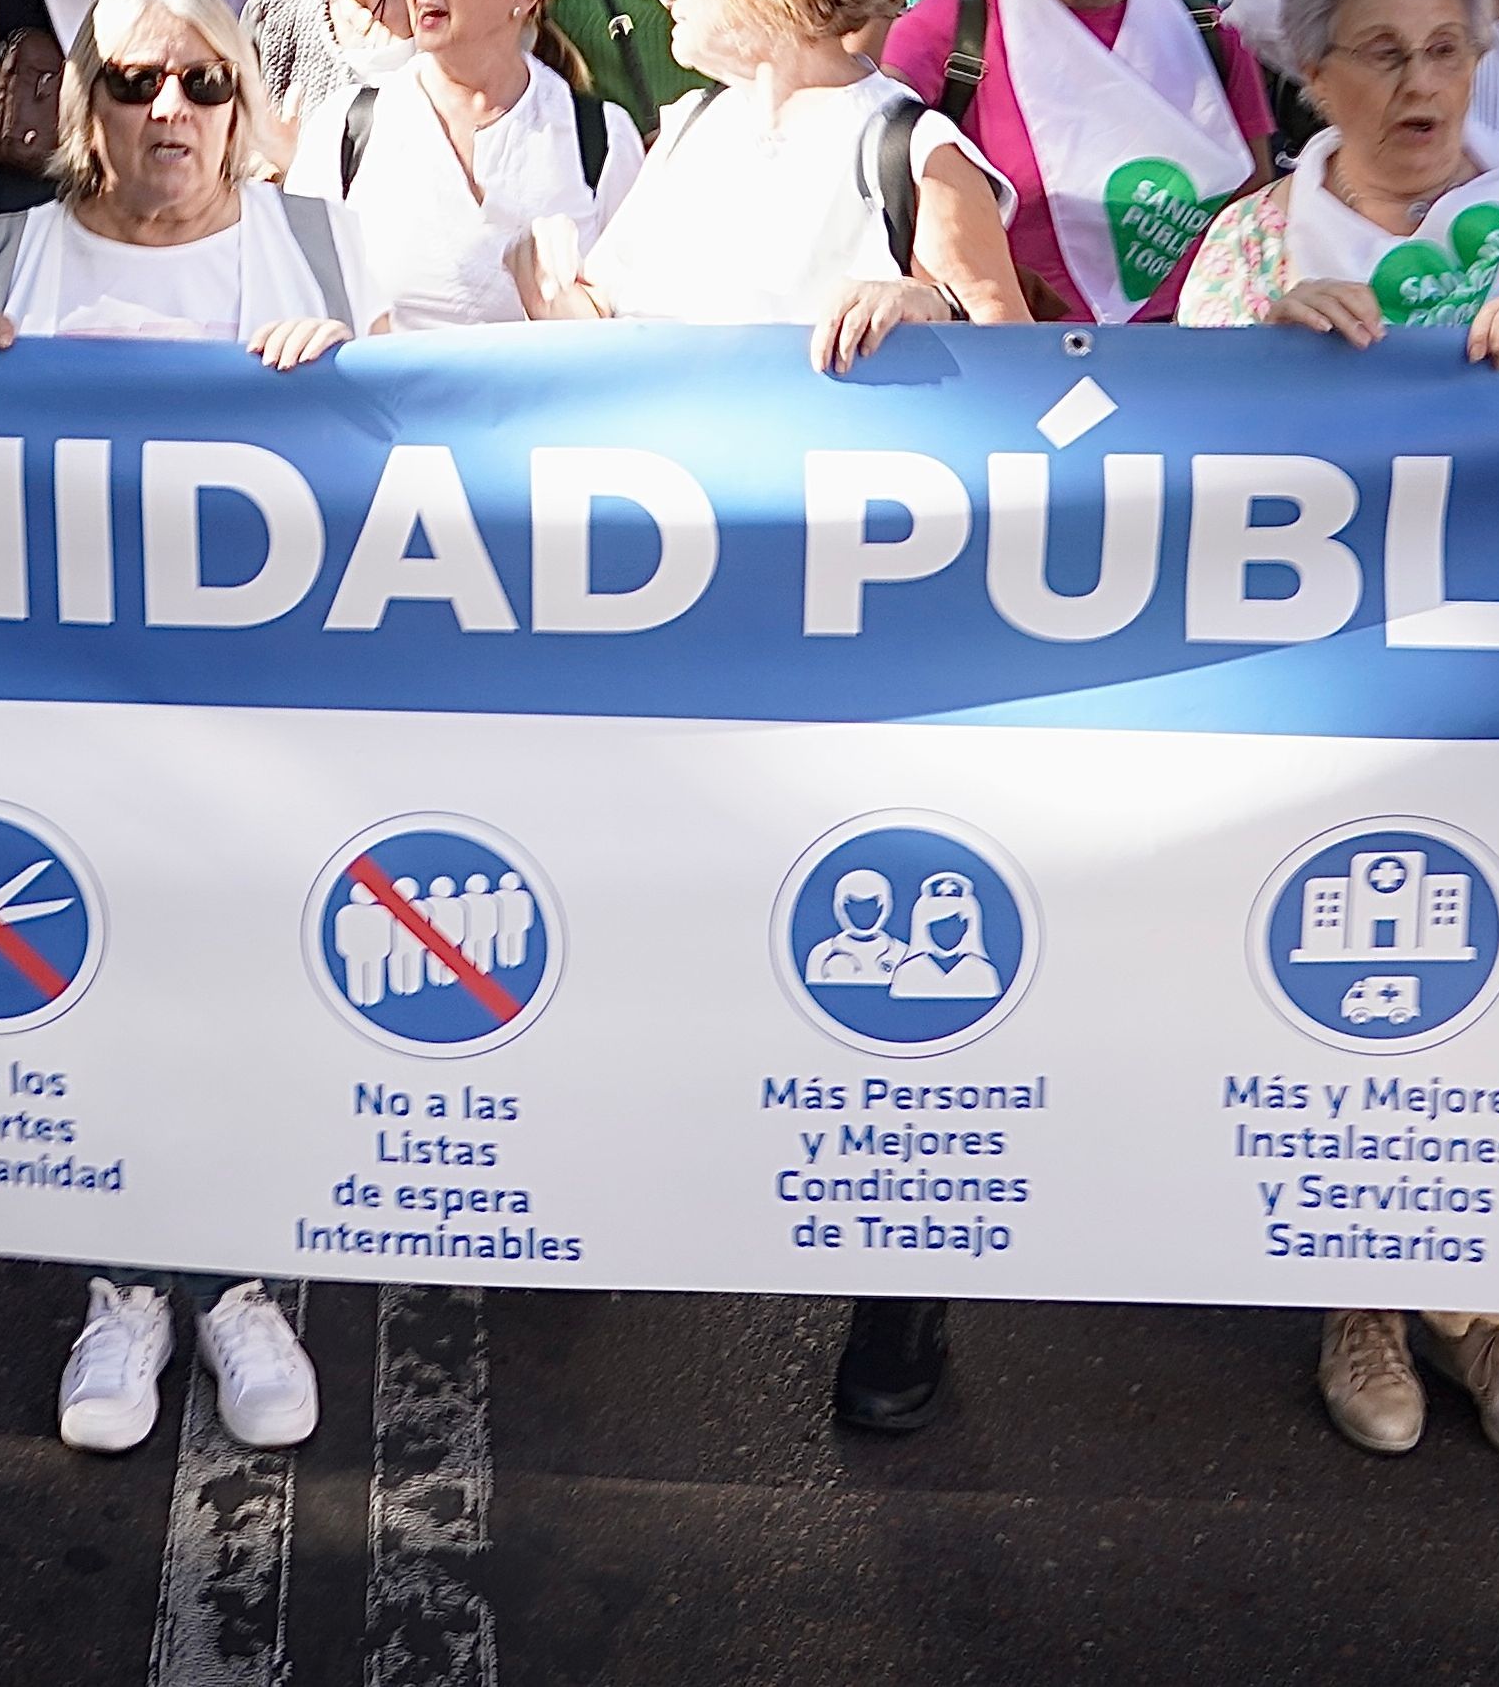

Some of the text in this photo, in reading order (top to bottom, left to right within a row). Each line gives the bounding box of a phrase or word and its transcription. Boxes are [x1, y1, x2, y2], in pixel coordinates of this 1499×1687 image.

[11, 1062, 65, 1096] los
[764, 1077, 1044, 1109] Más Personal
[1225, 1076, 1307, 1108] Más
[1324, 1085, 1349, 1119] y
[356, 1083, 517, 1120] No a las
[378, 1131, 496, 1166] Listas
[801, 1123, 1003, 1164] y Mejores
[334, 1175, 529, 1220] de espera
[778, 1169, 1027, 1202] Condiciones
[1261, 1175, 1492, 1216] y Servicios
[297, 1219, 580, 1261] Interminables
[795, 1216, 1009, 1257] de Trabajo
[1267, 1224, 1483, 1262] Sanitarios
